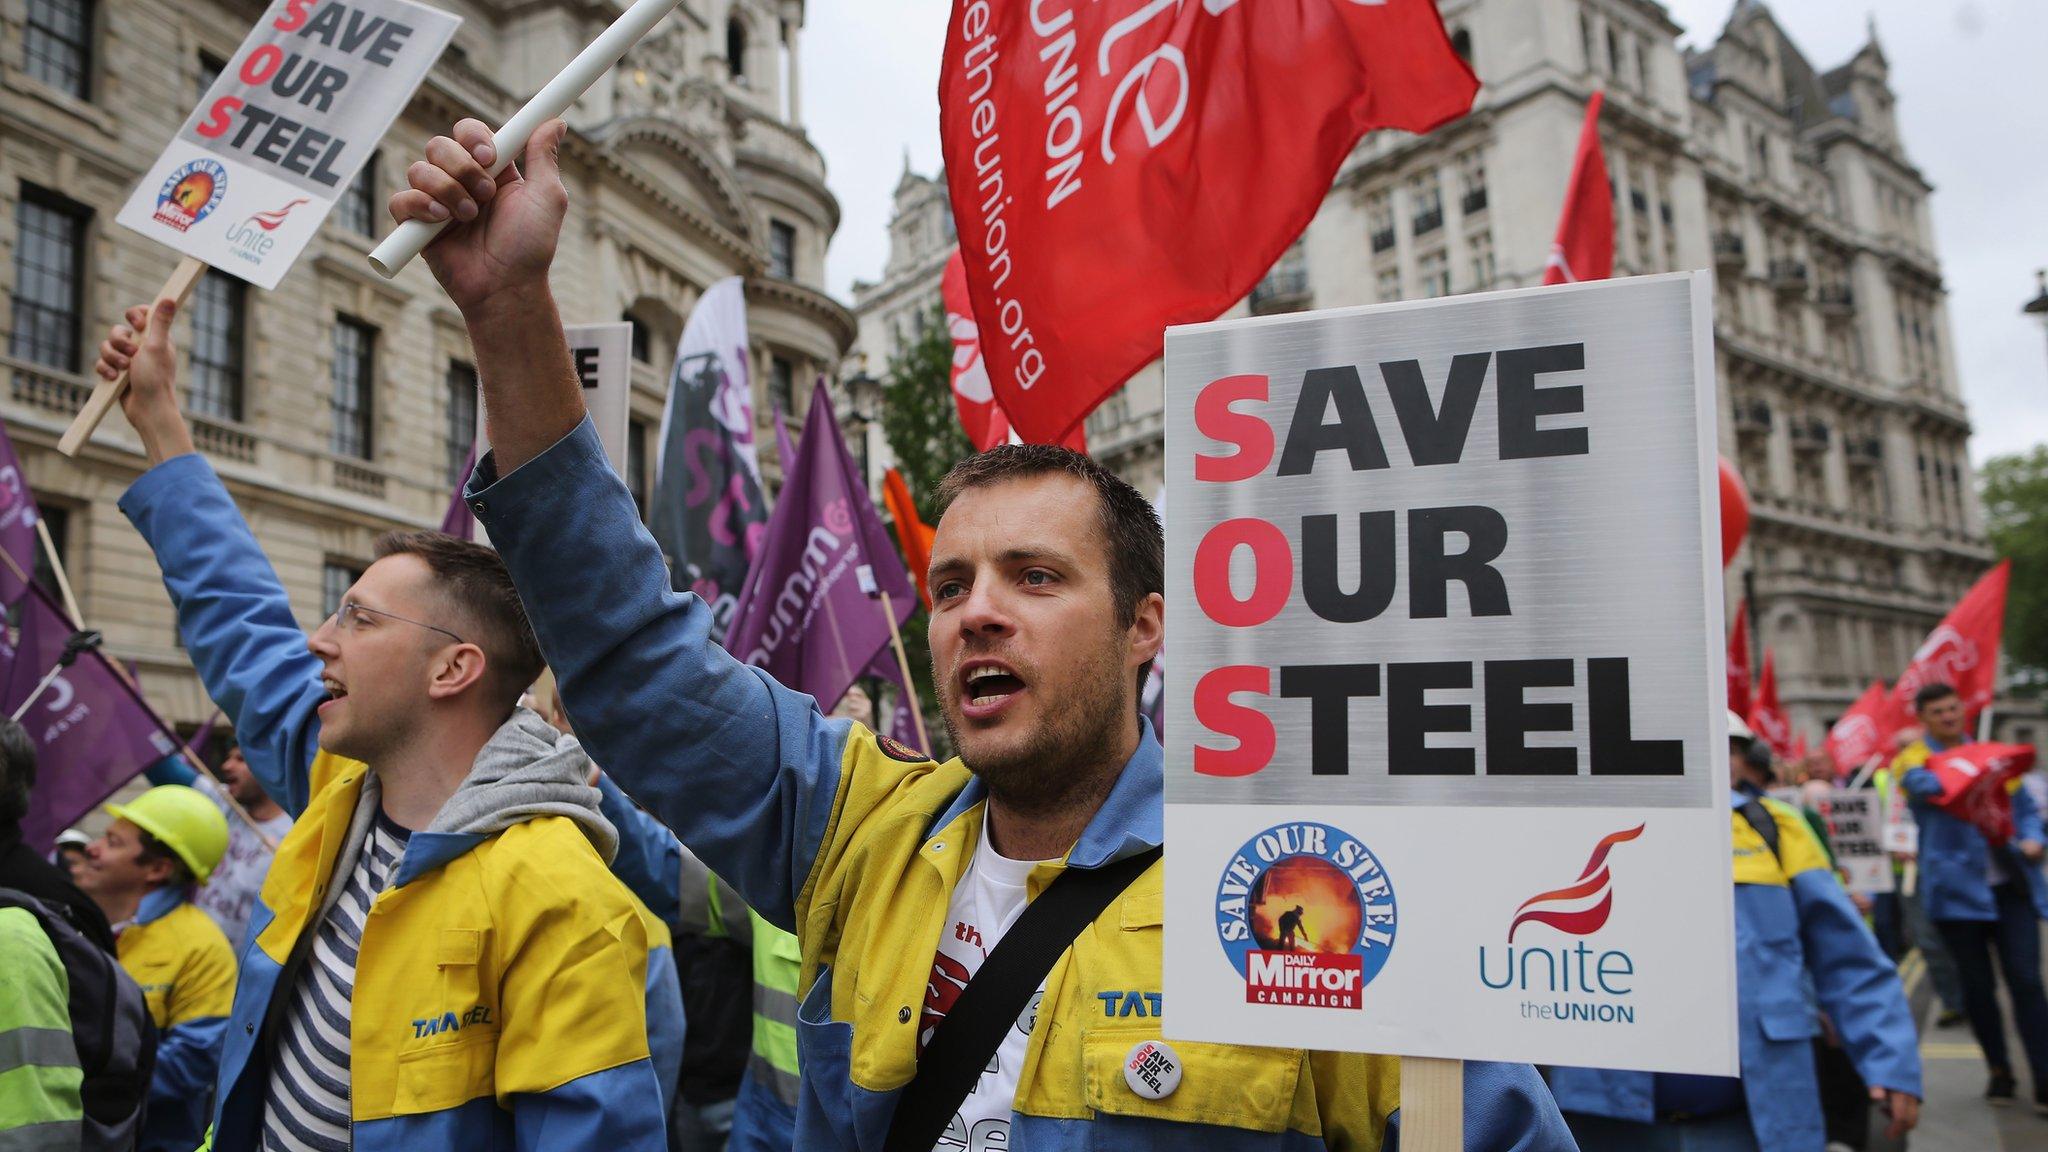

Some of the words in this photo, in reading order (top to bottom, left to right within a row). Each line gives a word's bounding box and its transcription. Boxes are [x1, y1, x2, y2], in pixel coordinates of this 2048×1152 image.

[272, 0, 414, 68] SAVE
[239, 43, 348, 114] OUR
[195, 95, 346, 188] STEEL
[963, 0, 1046, 390] etheunion.org
[226, 221, 274, 256] unite
[1193, 342, 1589, 483] SAVE
[1193, 505, 1512, 627] OUR
[1193, 657, 1684, 777] STEEL
[1219, 855, 1260, 942] SAVE
[1255, 825, 1328, 863] OUR
[1332, 840, 1394, 948] STEEL
[1249, 953, 1361, 992] Mirror
[1285, 954, 1317, 967] DAILY
[1480, 941, 1634, 995] unite
[1097, 991, 1162, 1017] TAT
[1257, 990, 1352, 1008] CAMPAIGN
[1520, 1001, 1634, 1023] theUNION
[412, 1011, 460, 1038] TAA
[1129, 1060, 1162, 1095] STEEL
[1136, 1051, 1162, 1077] OUR
[1145, 1044, 1175, 1074] SAVE
